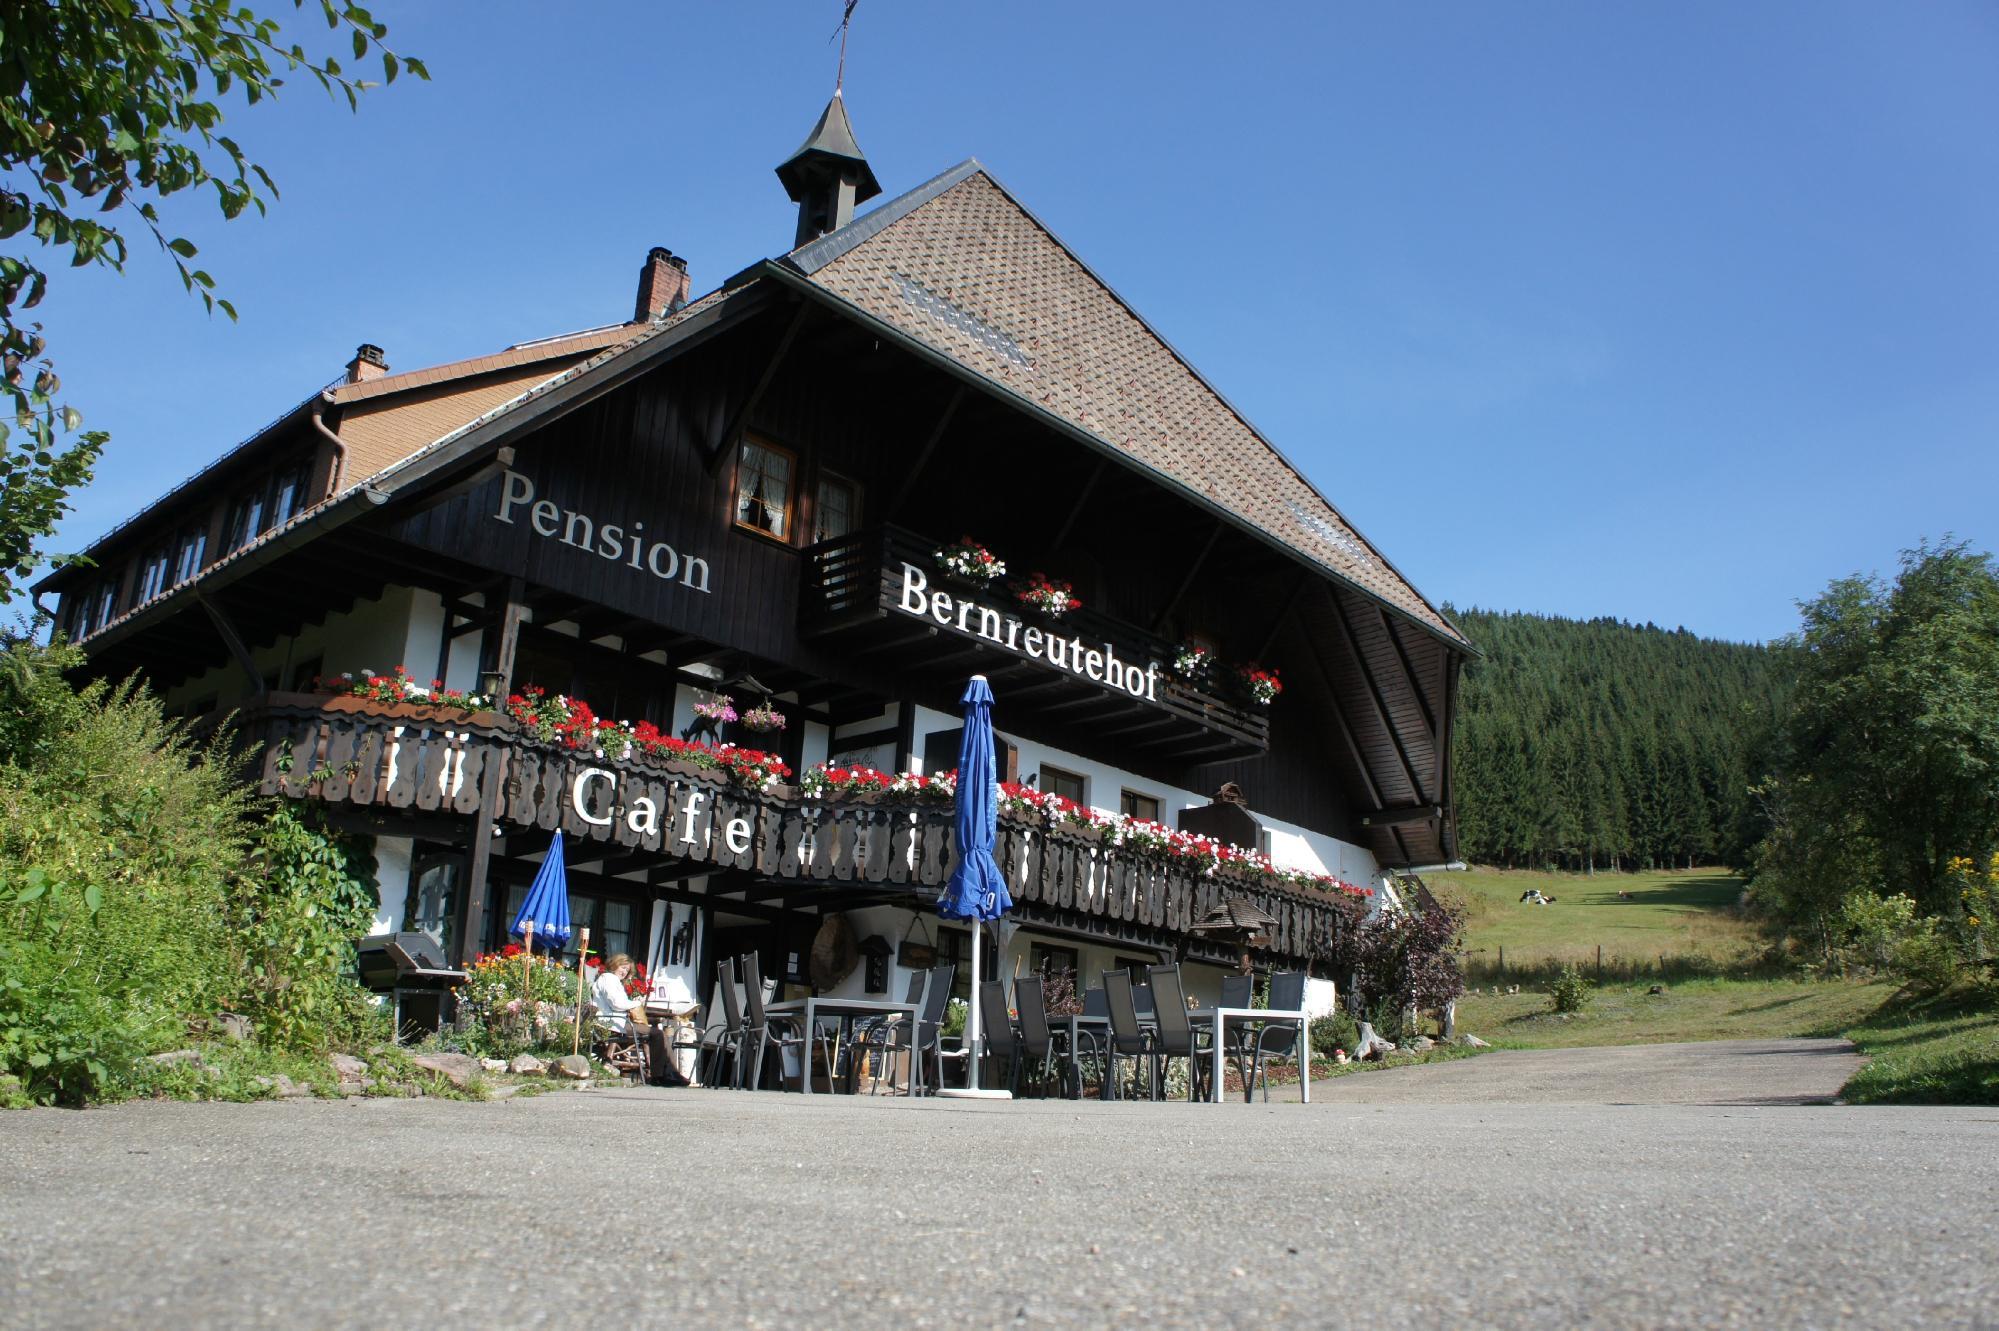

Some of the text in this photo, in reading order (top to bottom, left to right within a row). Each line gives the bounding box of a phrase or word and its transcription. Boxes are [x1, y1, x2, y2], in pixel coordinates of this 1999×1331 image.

[493, 469, 711, 594] Pension
[898, 561, 1159, 702] Bernreutehof
[572, 767, 751, 854] Cafe
